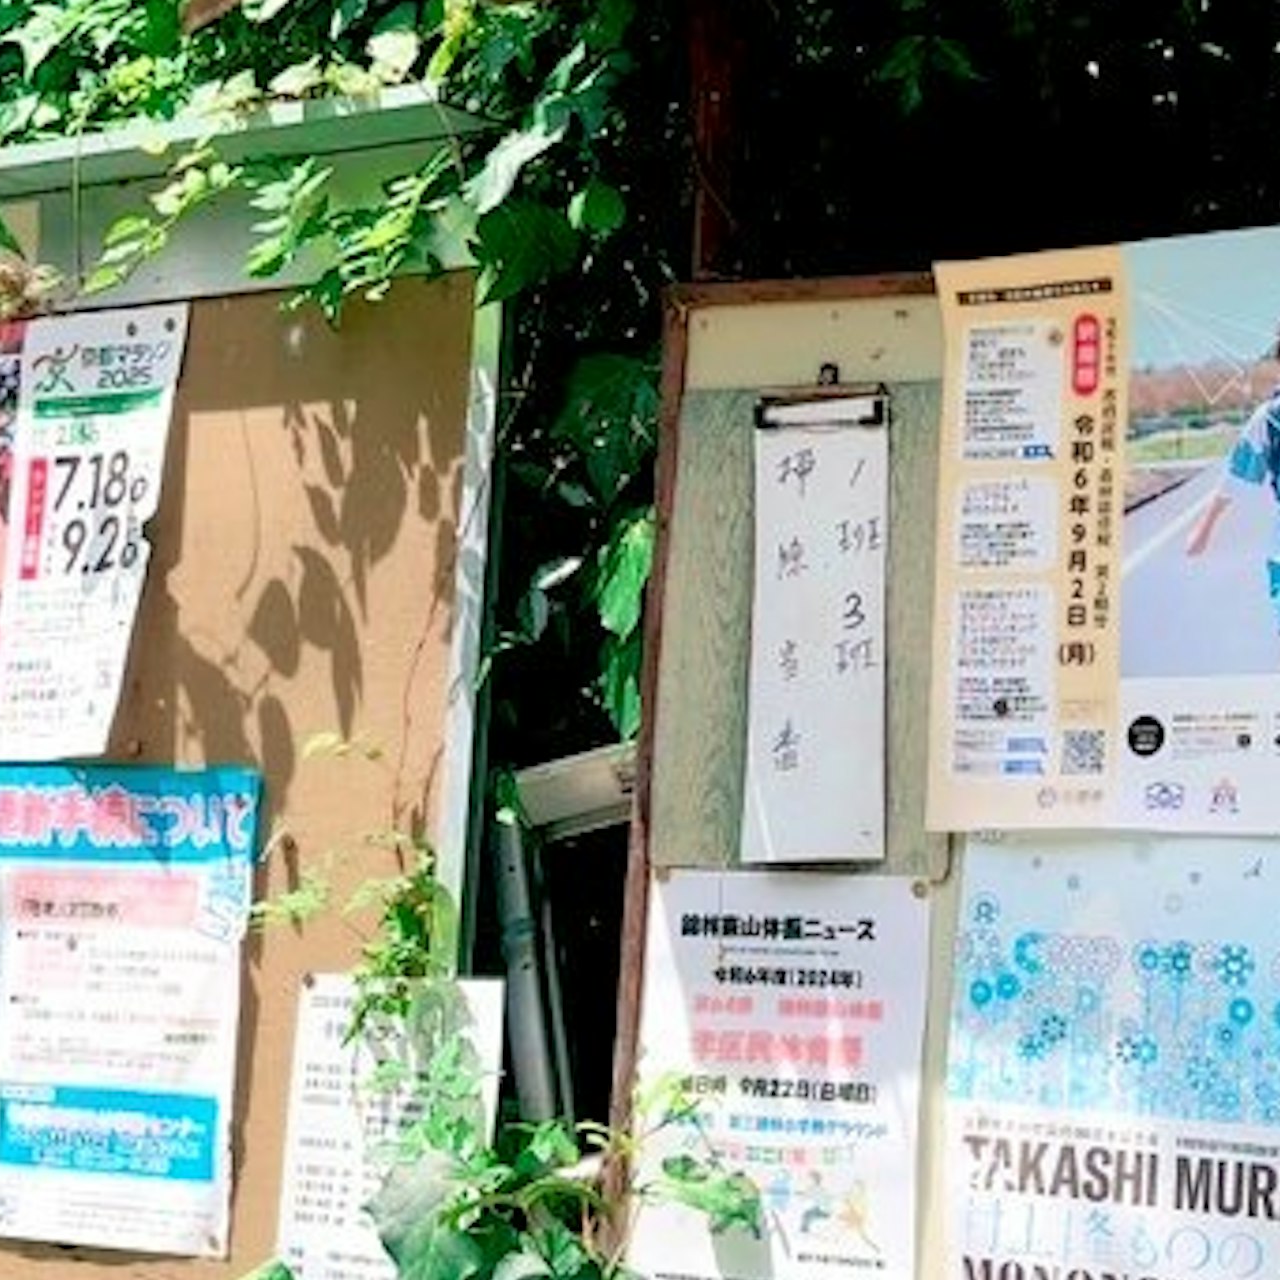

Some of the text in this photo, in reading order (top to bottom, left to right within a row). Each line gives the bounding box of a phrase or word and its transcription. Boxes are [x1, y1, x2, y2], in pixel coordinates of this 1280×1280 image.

[1059, 413, 1095, 666] 令和6年9月2日(月)
[963, 1133, 1160, 1208] TAKASHI
